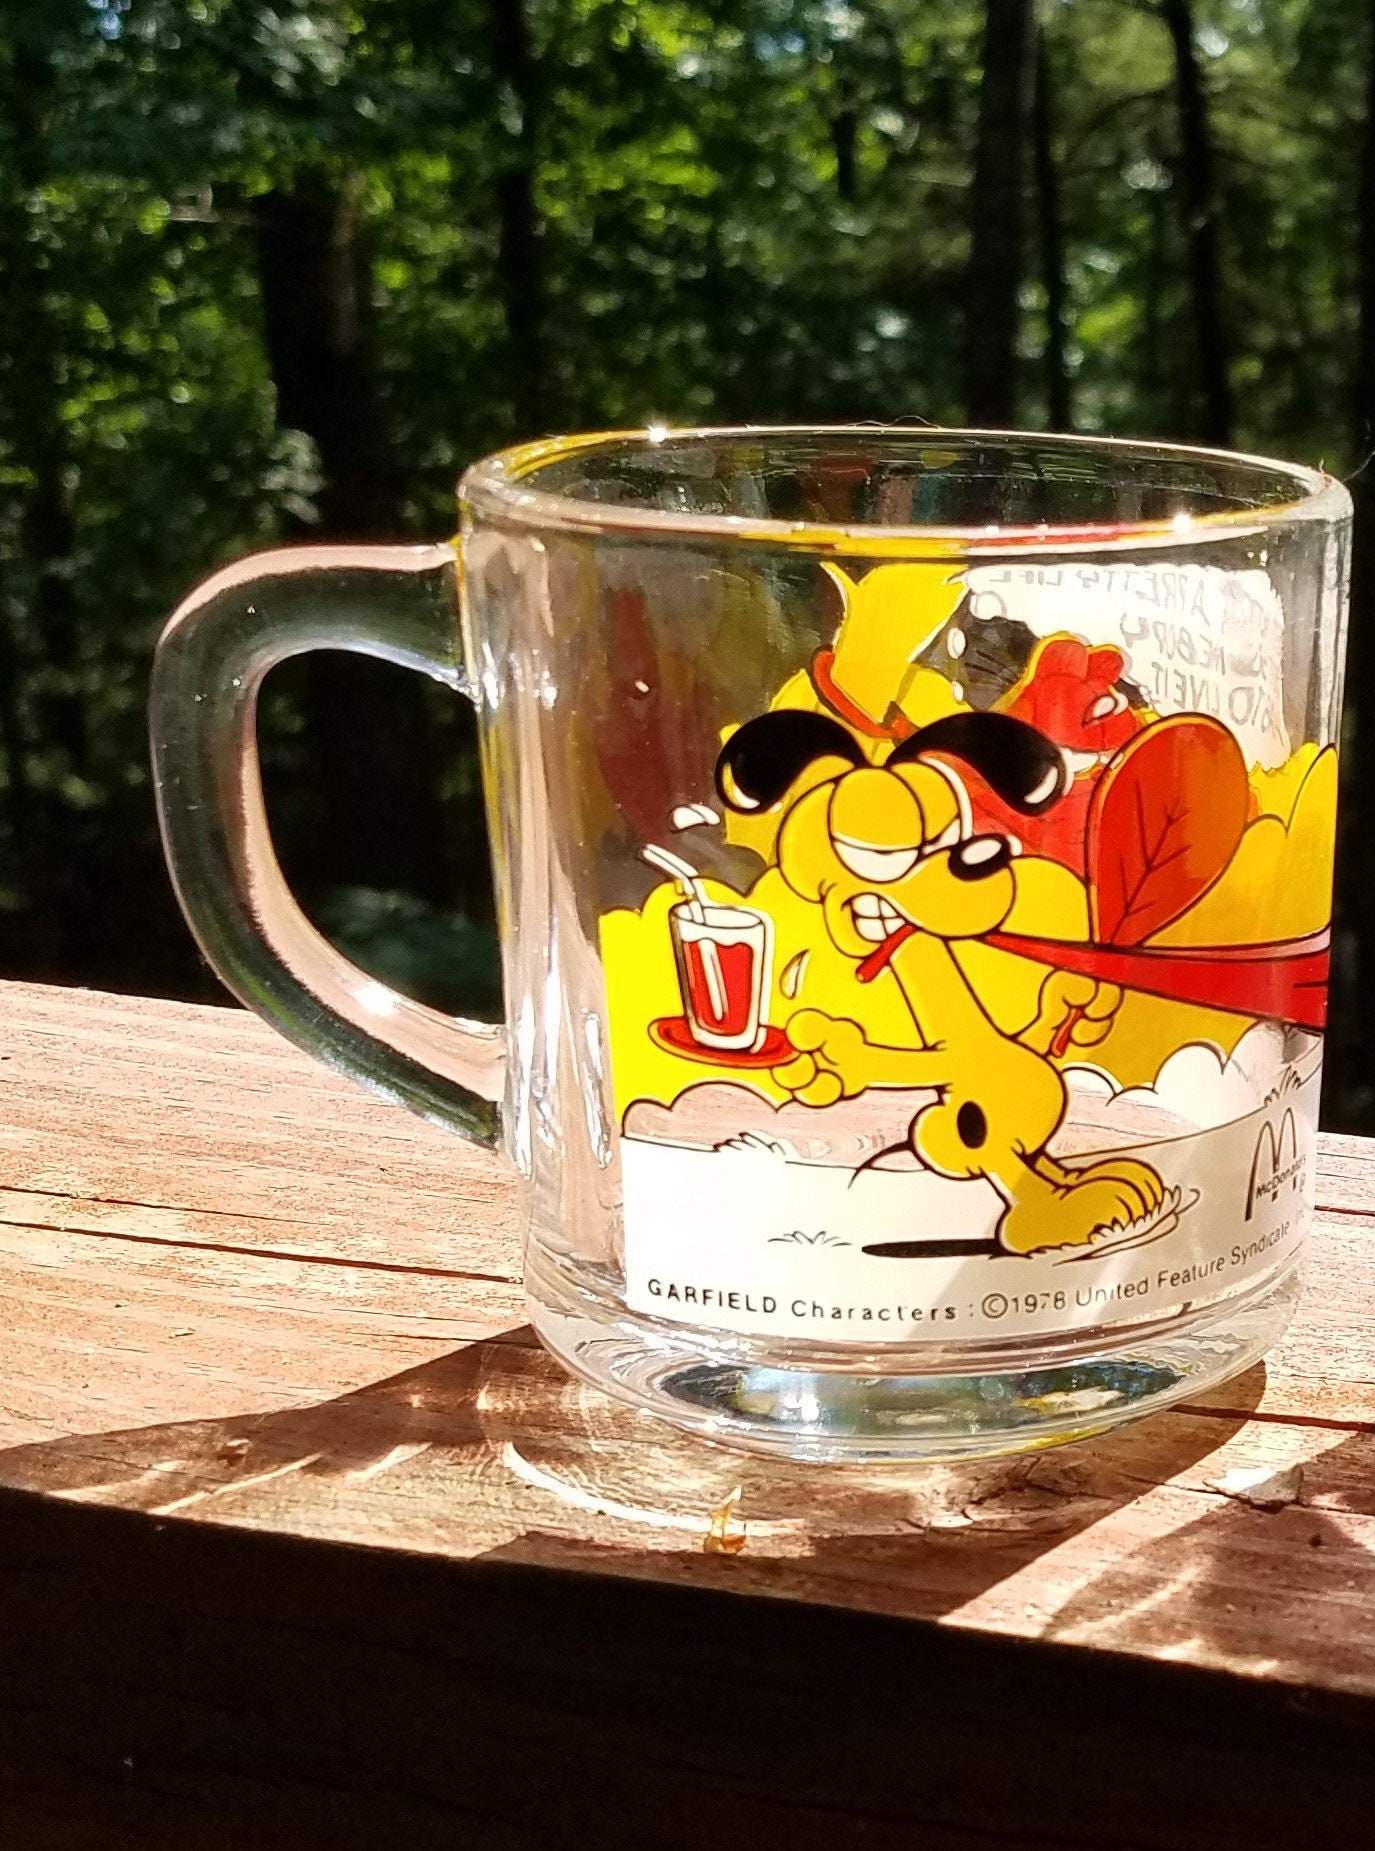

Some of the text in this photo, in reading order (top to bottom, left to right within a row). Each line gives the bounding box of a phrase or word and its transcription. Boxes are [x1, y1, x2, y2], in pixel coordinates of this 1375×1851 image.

[647, 1278, 777, 1314] GARFIELD
[791, 1299, 956, 1322] Characters
[1075, 1276, 1149, 1308] United
[1157, 1256, 1225, 1290] Feature
[1230, 1220, 1291, 1267] Syndicate
